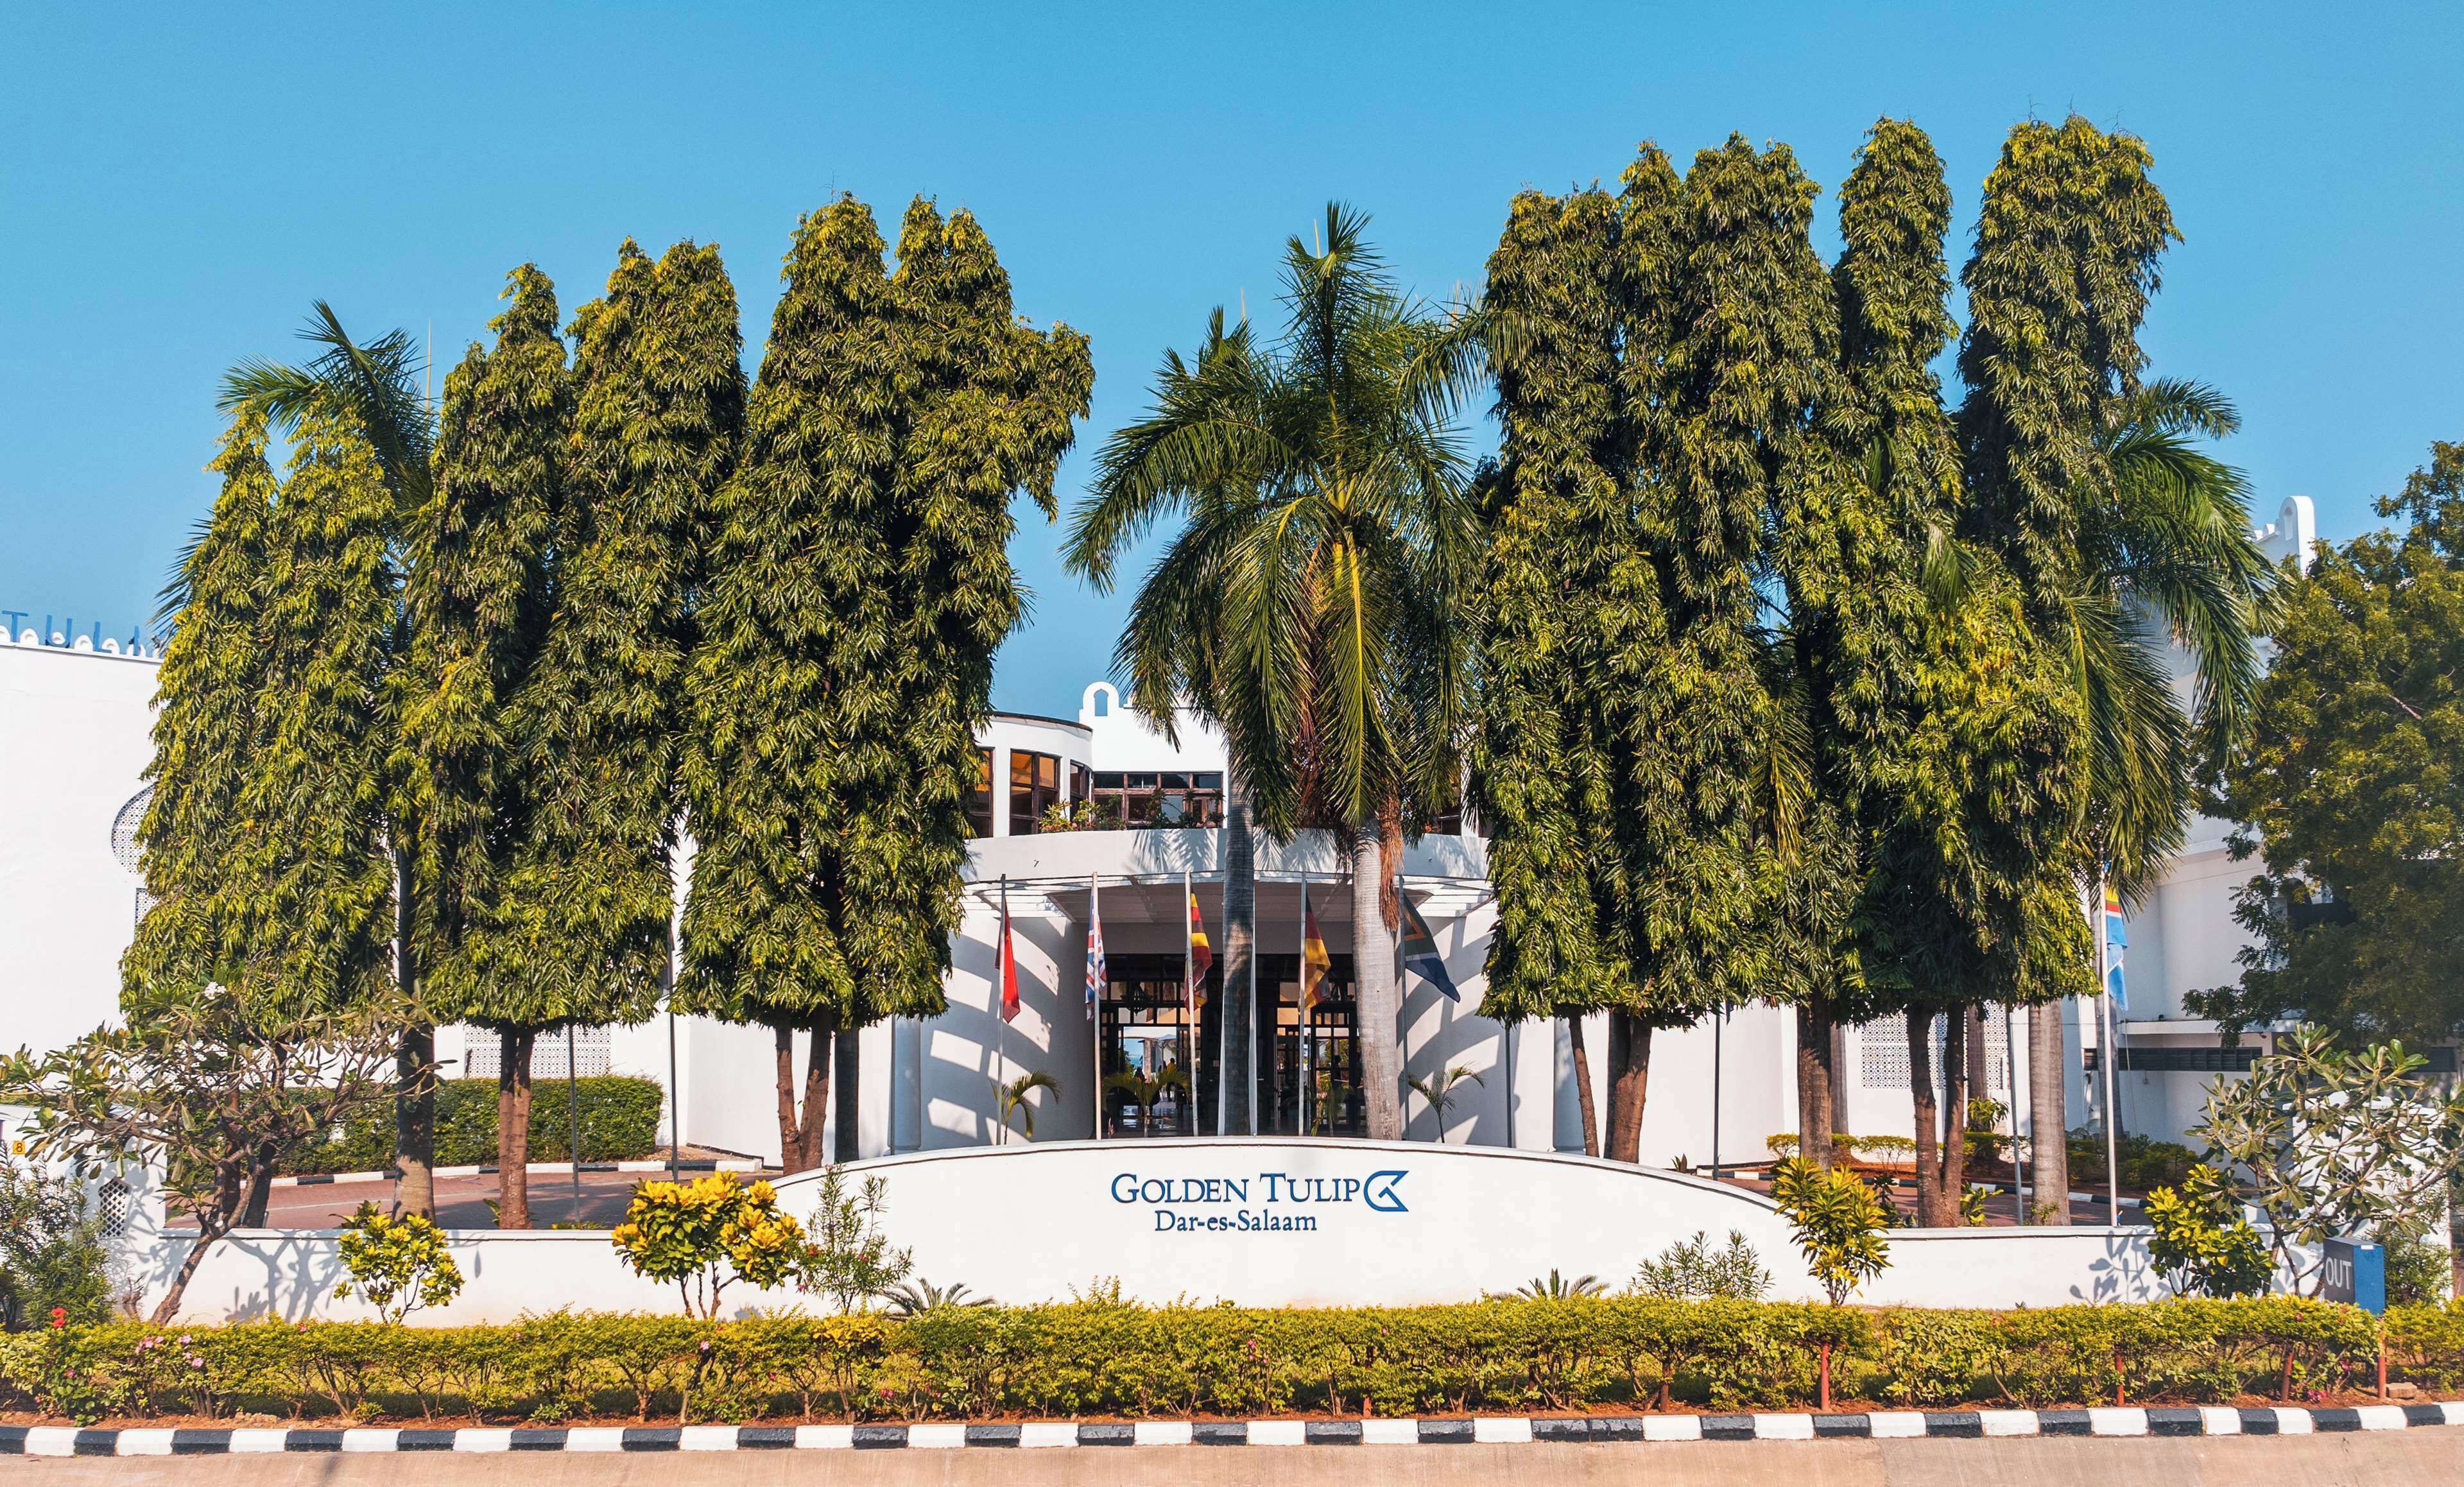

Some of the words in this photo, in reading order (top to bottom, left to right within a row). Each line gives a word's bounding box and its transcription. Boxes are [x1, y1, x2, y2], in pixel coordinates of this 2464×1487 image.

[1, 610, 140, 657] TULI
[17, 1142, 22, 1153] 8
[1111, 1173, 1250, 1204] GOLDEN
[1260, 1172, 1361, 1203] TULIP
[1155, 1209, 1318, 1232] Dar-es-Salaam
[2325, 1257, 2352, 1290] OUT
